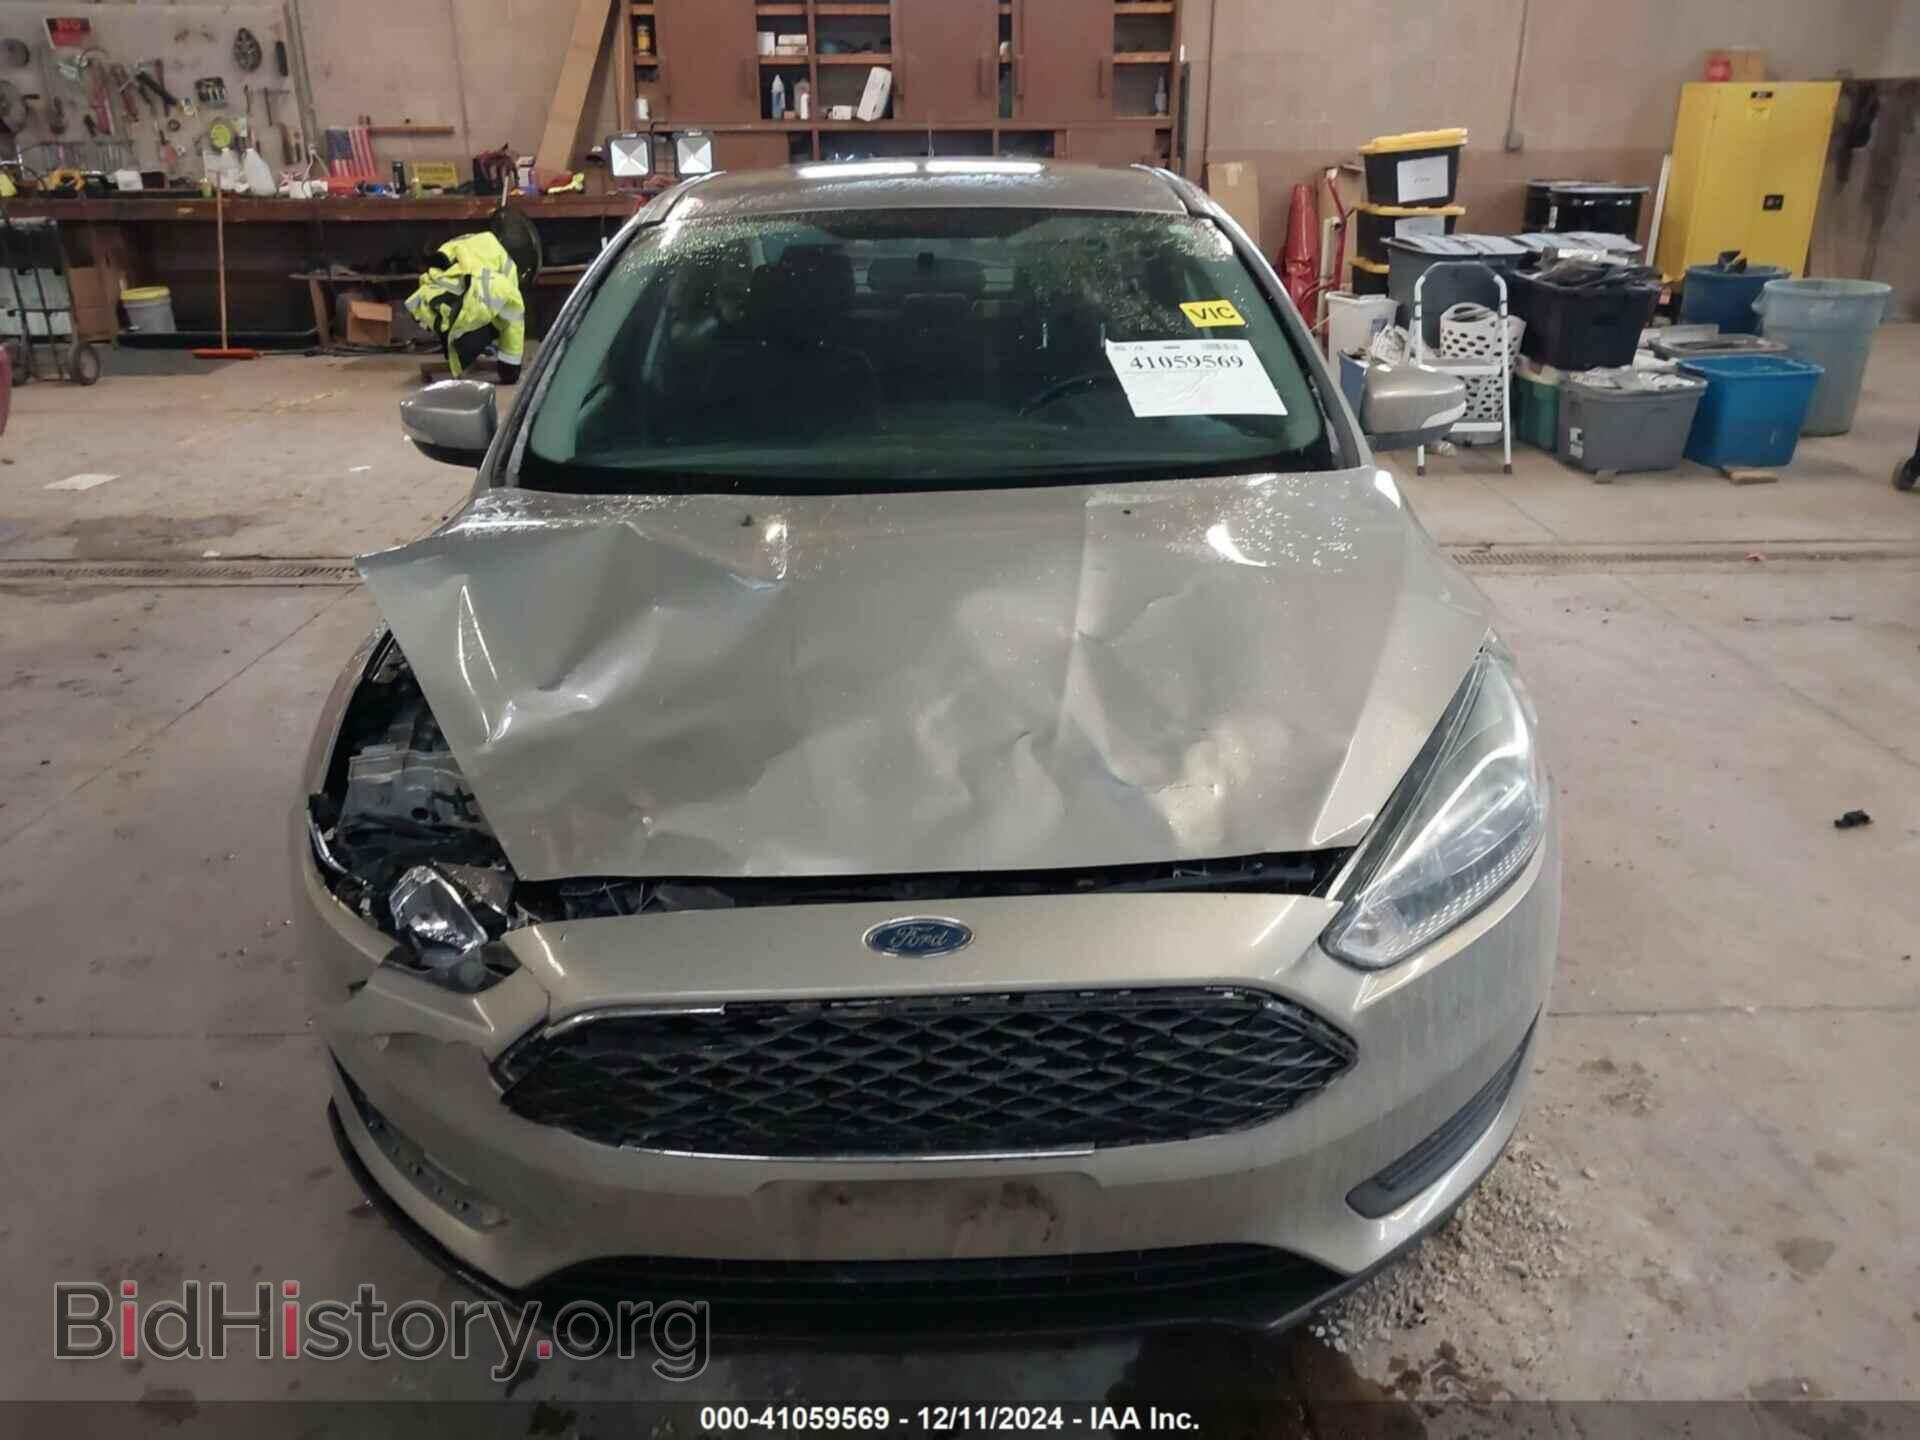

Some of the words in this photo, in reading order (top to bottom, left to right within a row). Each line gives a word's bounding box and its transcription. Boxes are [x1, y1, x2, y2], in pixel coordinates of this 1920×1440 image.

[1189, 305, 1236, 321] VIC
[1130, 354, 1244, 370] 41059569
[890, 925, 949, 948] Ford
